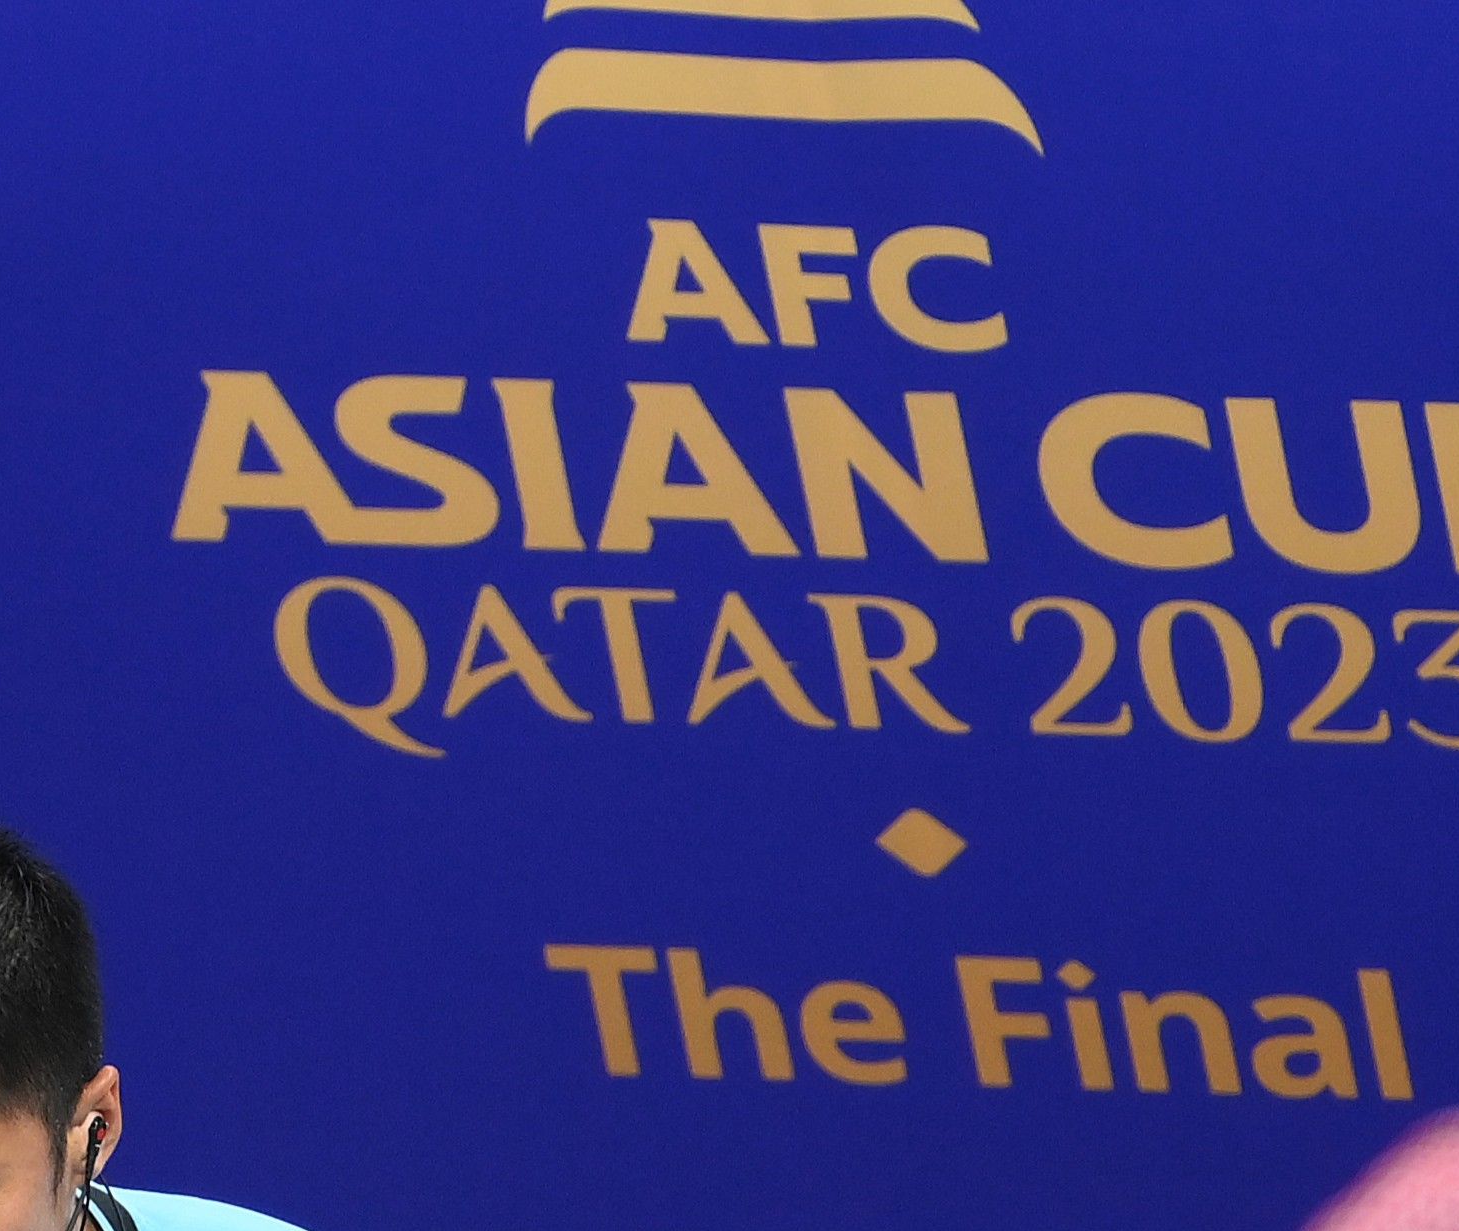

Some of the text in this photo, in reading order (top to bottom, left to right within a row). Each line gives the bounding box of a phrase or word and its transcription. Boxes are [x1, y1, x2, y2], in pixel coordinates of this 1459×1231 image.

[628, 219, 1009, 353] AFC
[172, 370, 990, 563] ASIAN
[275, 576, 970, 758] QATAR
[545, 944, 1414, 1101] The Final
